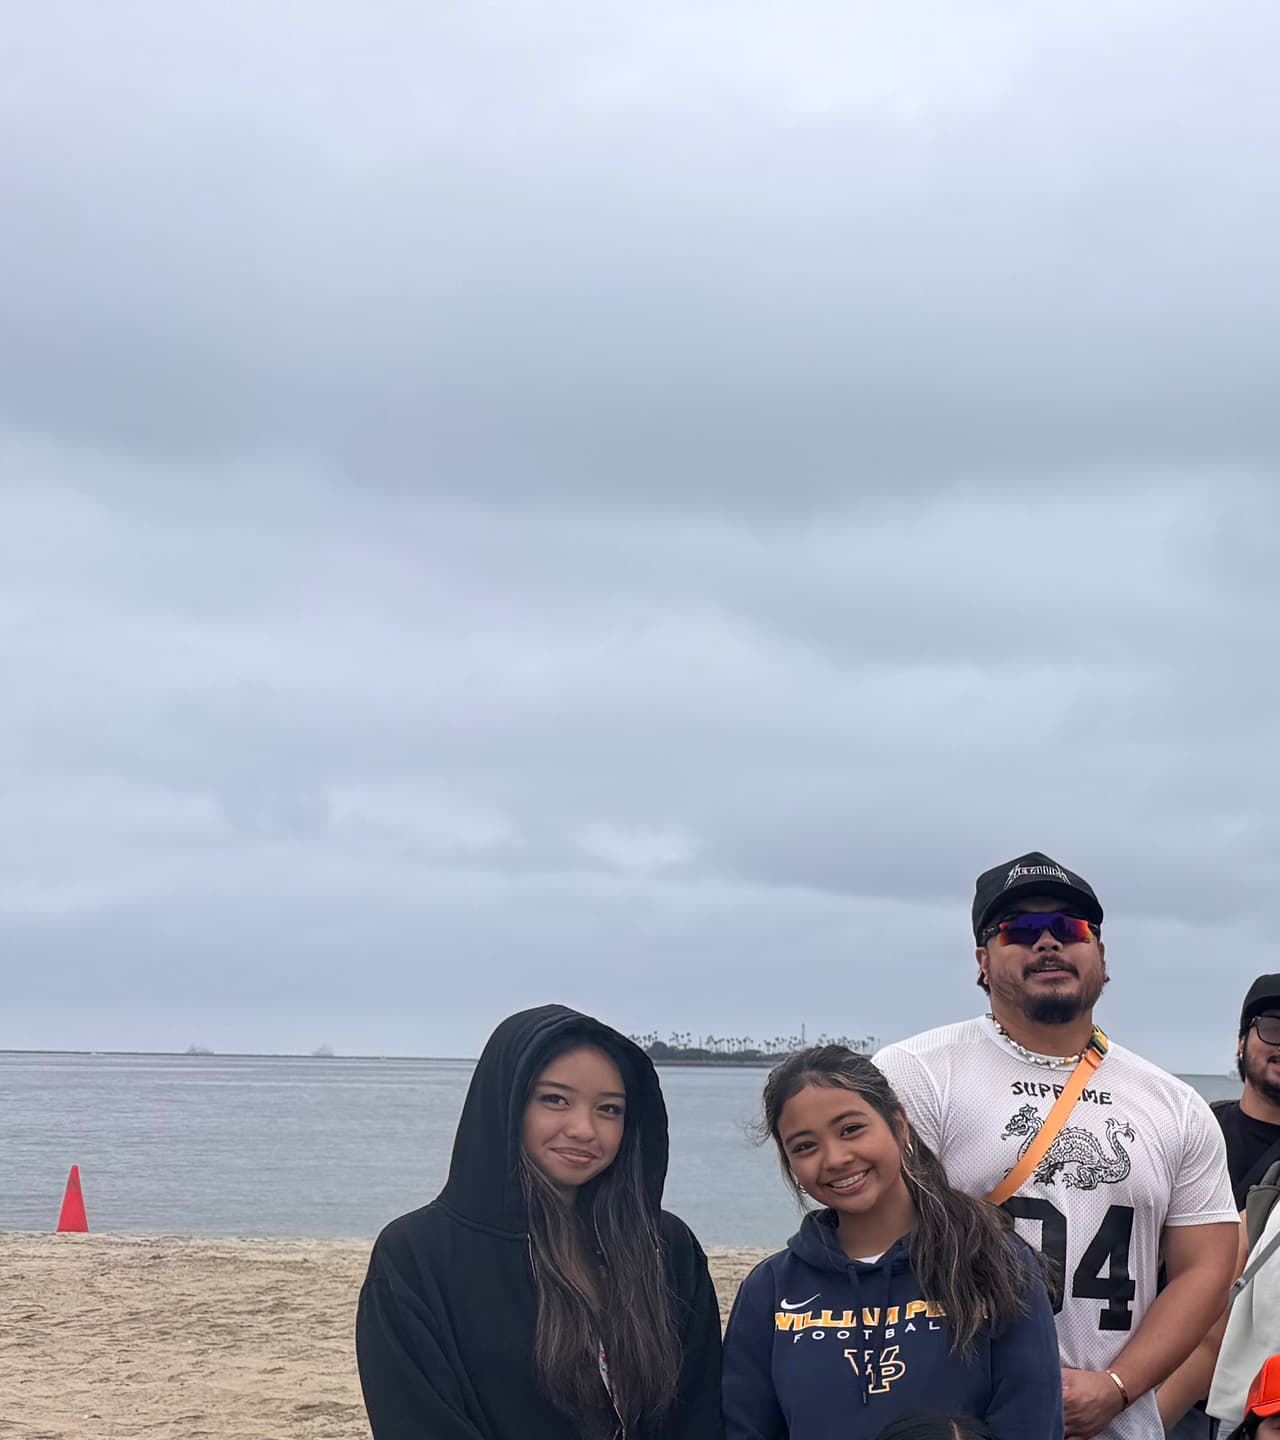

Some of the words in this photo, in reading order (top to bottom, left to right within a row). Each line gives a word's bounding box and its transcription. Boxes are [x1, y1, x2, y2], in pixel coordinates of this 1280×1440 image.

[1011, 1081, 1113, 1105] SUPRME
[774, 1306, 900, 1332] WILLIM
[793, 1321, 941, 1344] FOOTBAL
